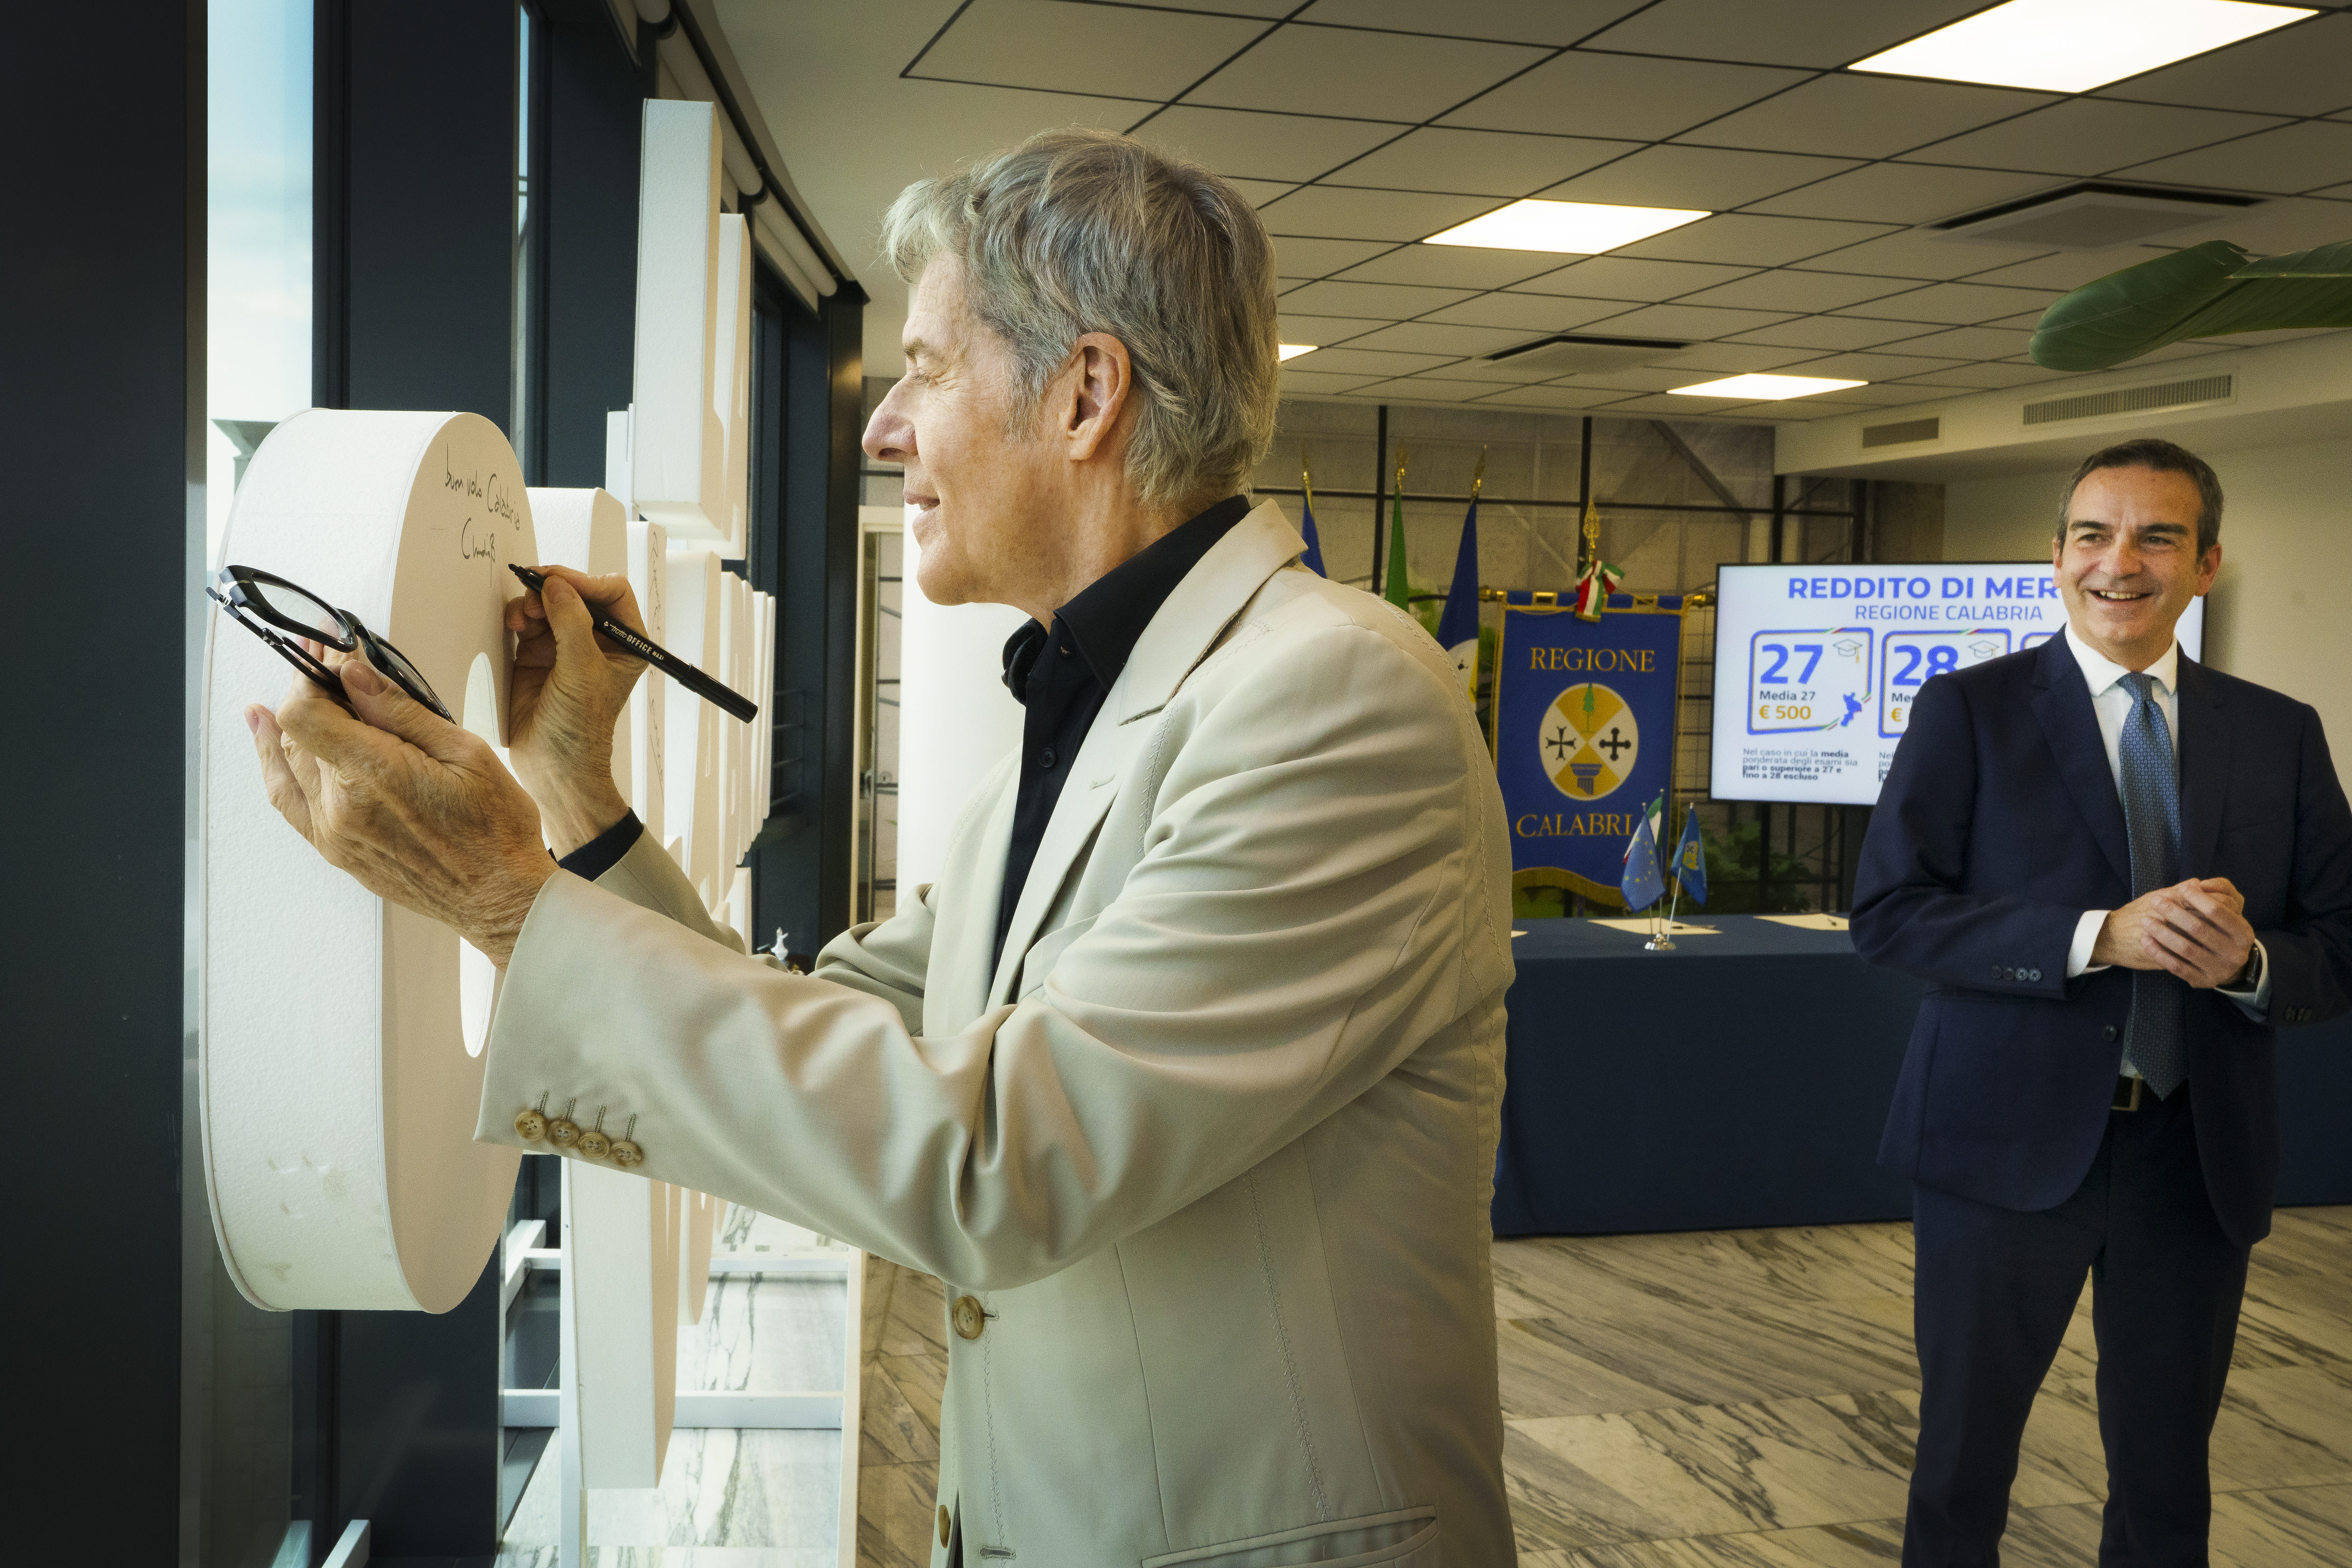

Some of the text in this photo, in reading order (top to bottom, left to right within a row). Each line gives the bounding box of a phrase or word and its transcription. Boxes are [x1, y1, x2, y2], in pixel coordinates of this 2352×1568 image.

[488, 473, 520, 531] Calabria
[1788, 577, 2058, 599] REDDITO DI MER
[1855, 605, 2042, 620] REGIONE CALABRIA
[627, 635, 652, 654] OFFICE
[652, 651, 664, 661] MAXI
[1529, 647, 1656, 672] REGIONE
[1760, 644, 1823, 685] 27
[1892, 644, 1959, 686] 28
[1759, 690, 1816, 701] Media 27
[1759, 705, 1812, 720] € 500
[1743, 757, 1788, 765] ponderata
[1770, 765, 1811, 774] superiore
[1516, 813, 1632, 837] CALABRI
